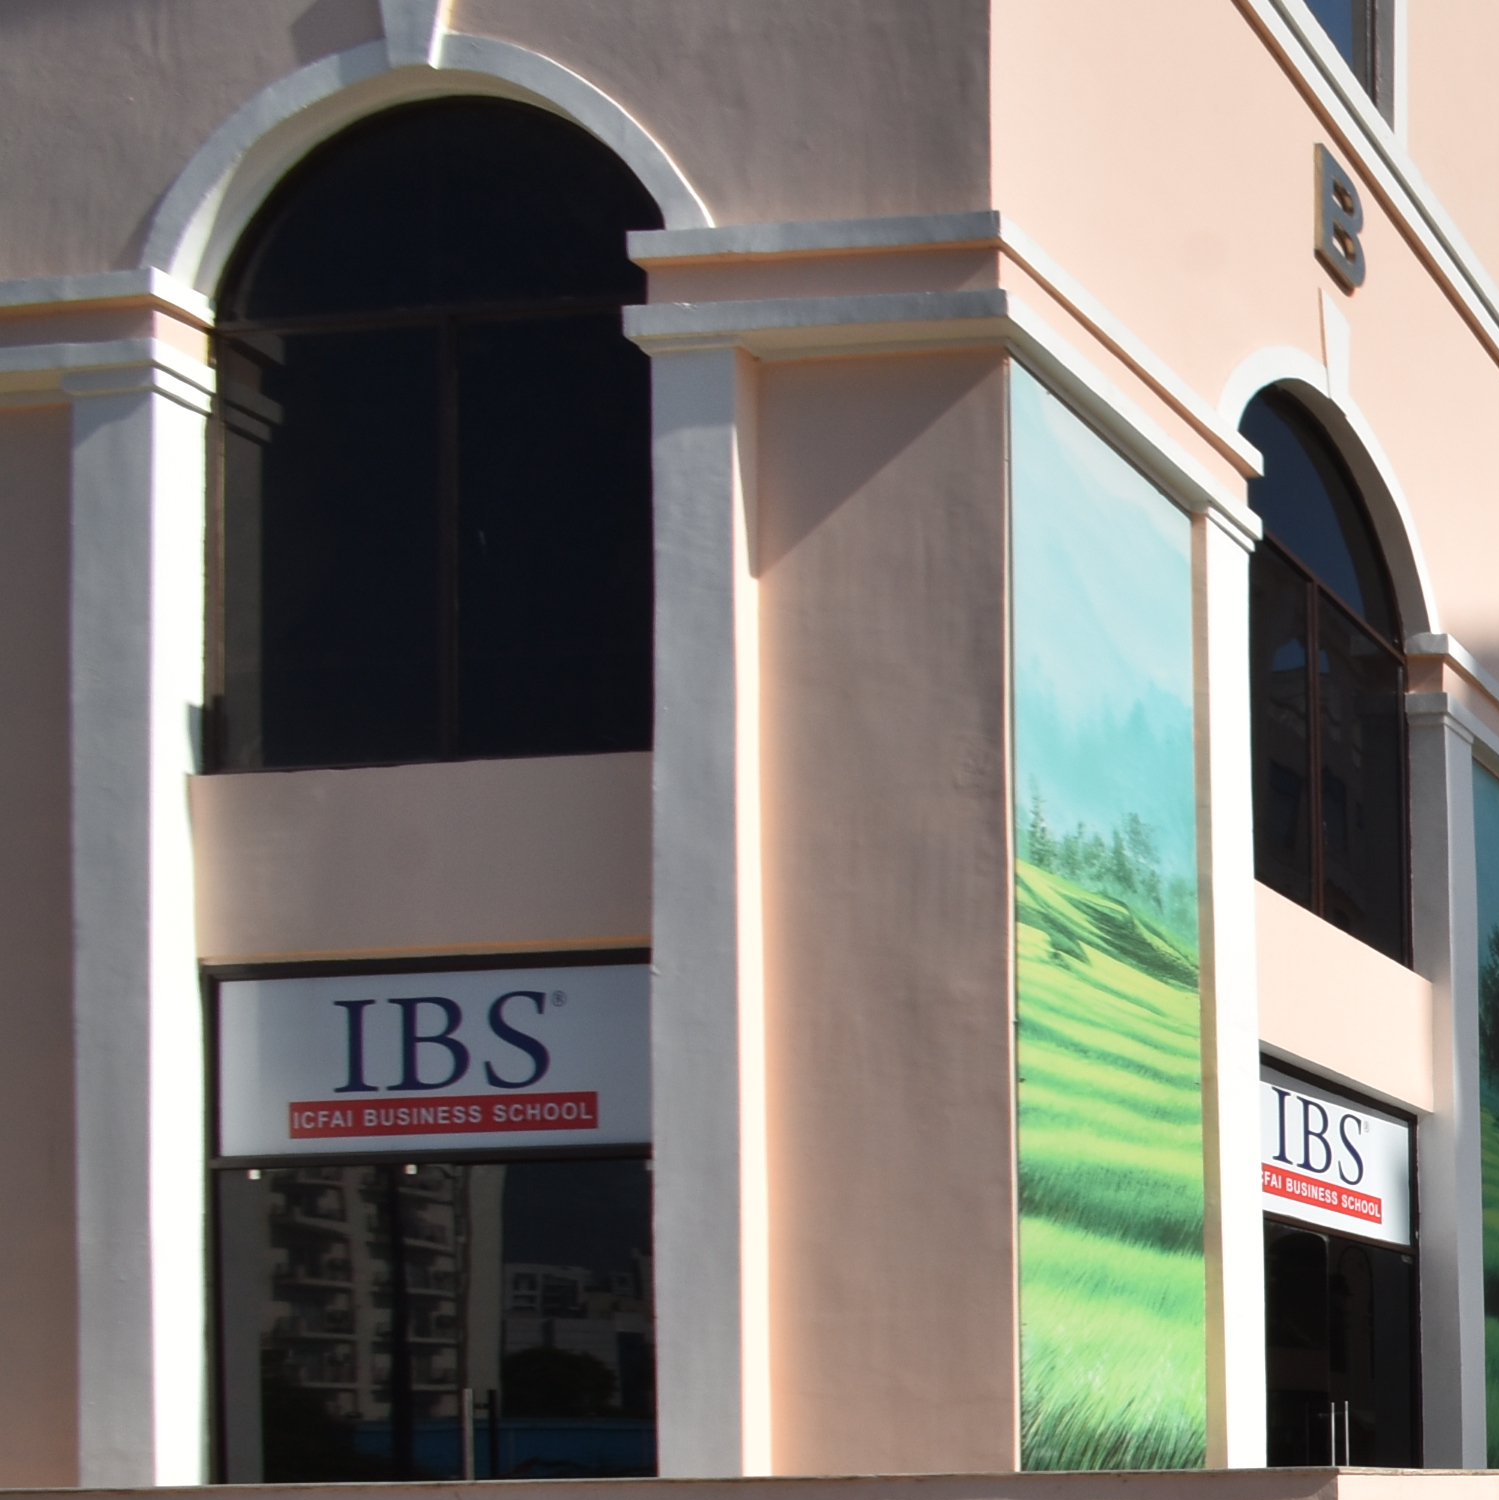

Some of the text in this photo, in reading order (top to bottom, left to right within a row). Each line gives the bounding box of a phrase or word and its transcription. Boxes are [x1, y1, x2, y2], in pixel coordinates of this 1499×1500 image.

[1314, 142, 1366, 297] B
[333, 990, 550, 1093] IBS
[293, 1102, 593, 1129] ICFAI BUSINESS SCHOOL
[1271, 1086, 1364, 1186] IBS
[1286, 1177, 1338, 1205] BUSINESS
[1341, 1193, 1381, 1218] SCHOOL
